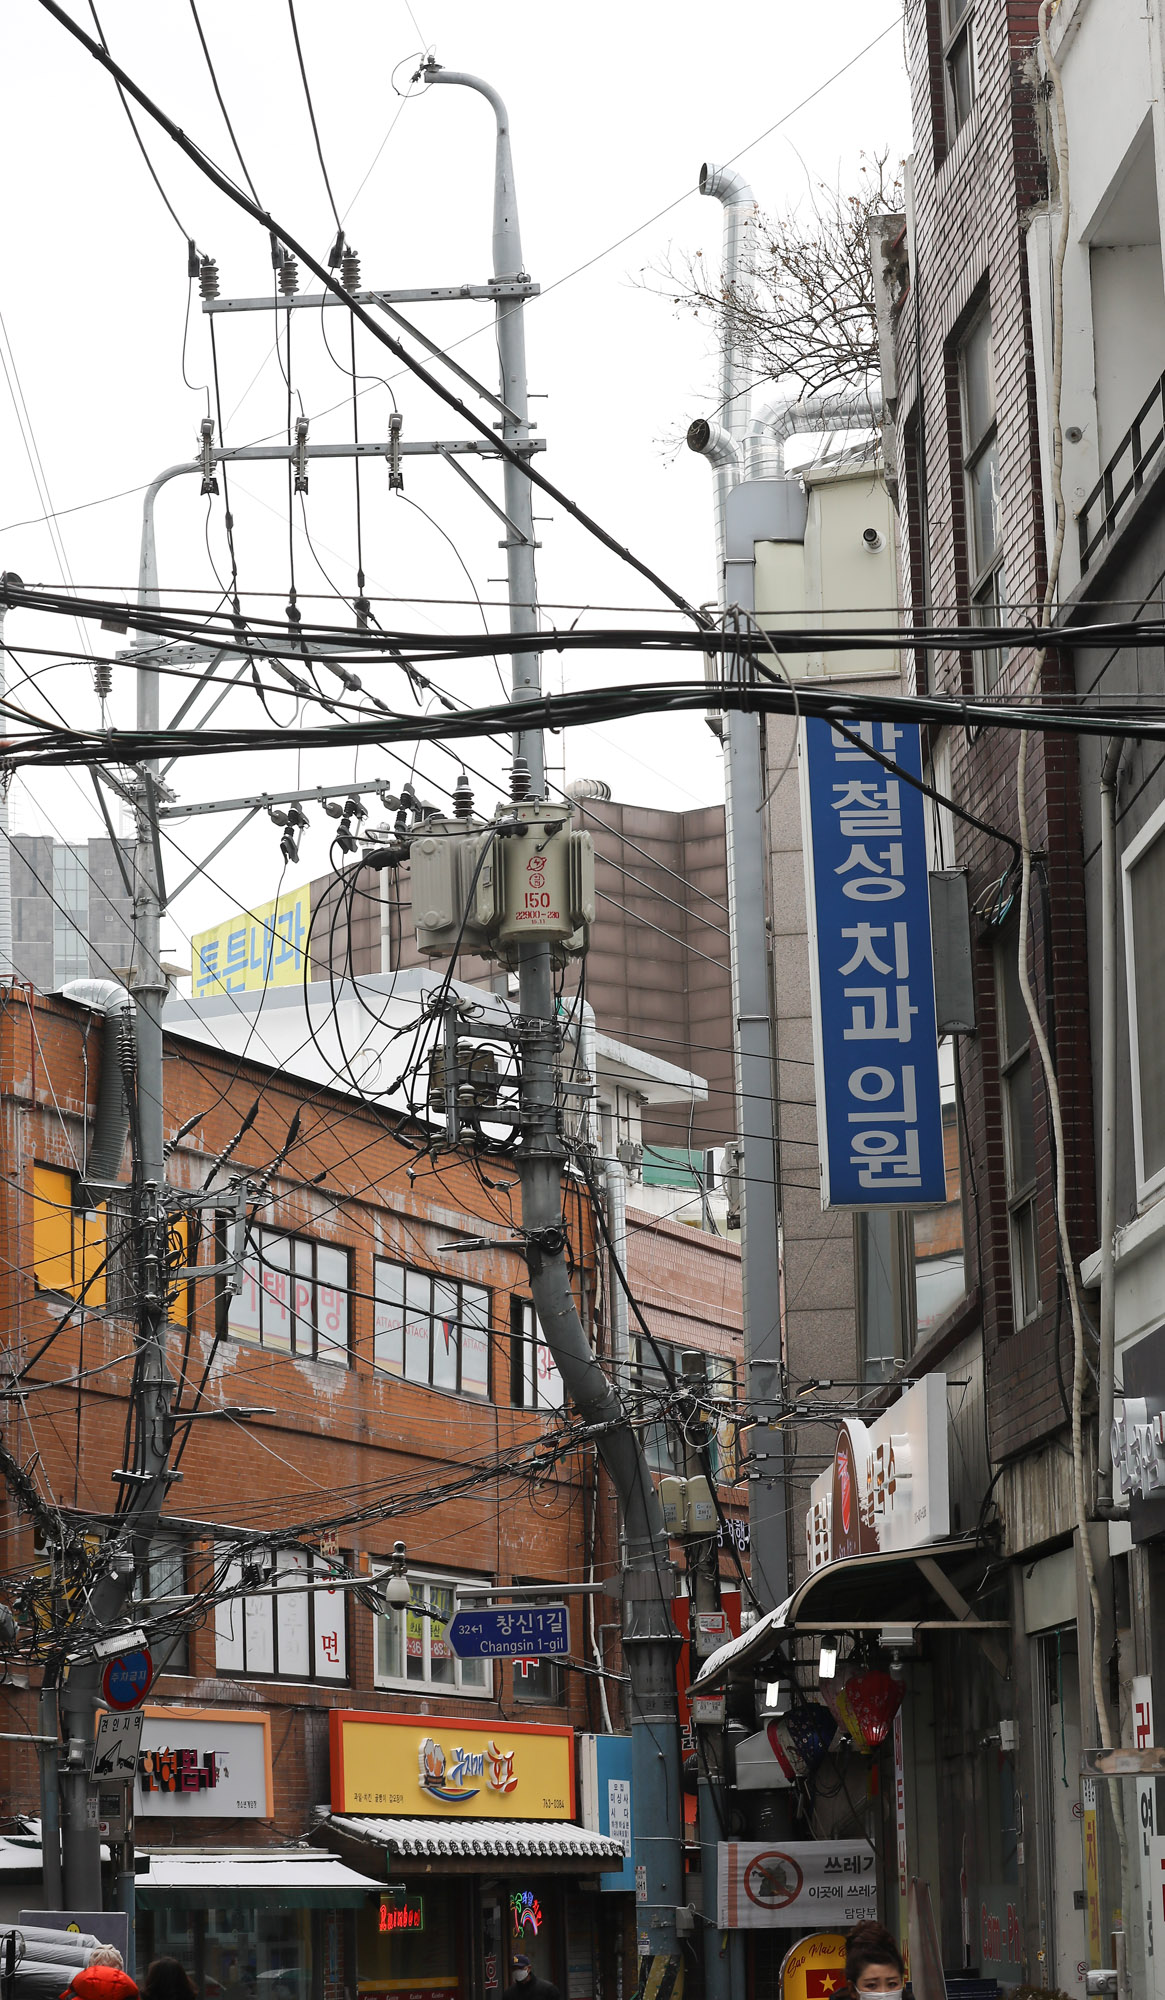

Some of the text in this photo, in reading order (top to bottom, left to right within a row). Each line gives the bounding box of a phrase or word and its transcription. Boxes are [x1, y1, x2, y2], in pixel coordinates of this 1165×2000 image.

[524, 892, 550, 909] 150
[196, 901, 306, 997] 튼튼내과
[830, 720, 922, 1188] 박철성 치과 의원
[496, 1611, 563, 1636] 창신1길
[479, 1637, 564, 1655] Changsin 1-gil
[110, 1670, 147, 1683] 주차금지
[100, 1716, 142, 1733] 견인지역
[448, 1740, 519, 1793] 무지개 호프
[542, 1798, 565, 1809] 763-0384
[808, 1885, 843, 1899] 이곳에
[379, 1903, 421, 1931] Rainbow
